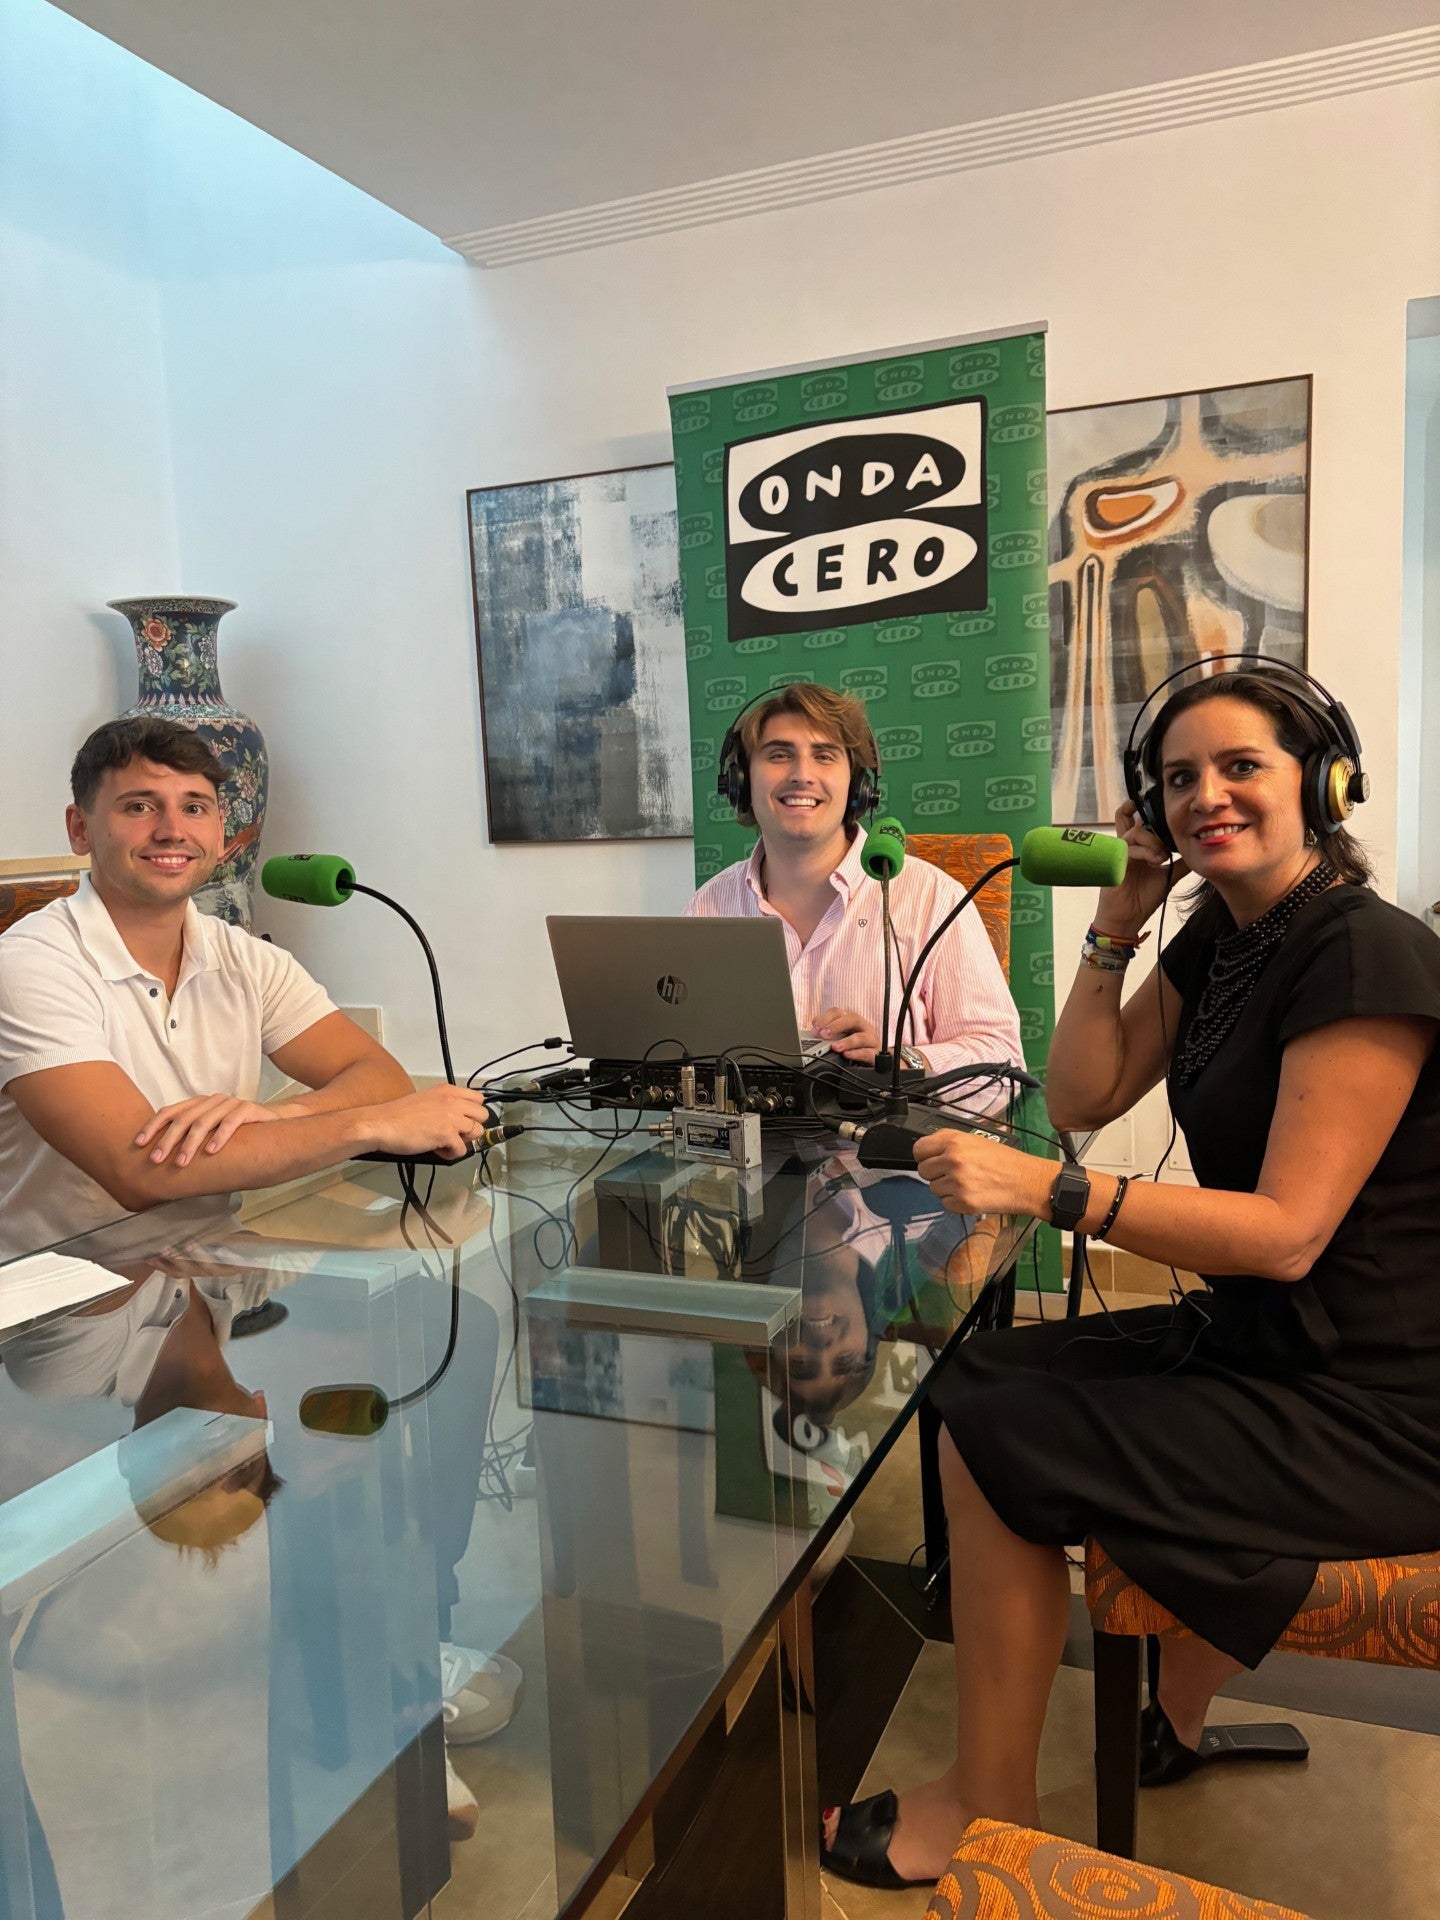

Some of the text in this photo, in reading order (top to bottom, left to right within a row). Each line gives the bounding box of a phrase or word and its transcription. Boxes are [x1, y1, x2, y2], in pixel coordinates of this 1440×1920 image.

[955, 356, 993, 370] ONDA
[957, 373, 994, 387] CERO
[995, 411, 1033, 424] ONDA
[998, 427, 1036, 440] CERO
[759, 453, 943, 515] ONDA
[996, 537, 1035, 549] ONDA
[998, 553, 1035, 566] CERO
[772, 536, 945, 597] CERO
[954, 621, 990, 633] CERO
[809, 633, 841, 644] CERO
[882, 628, 916, 640] CERO
[741, 639, 773, 650] CERO
[991, 660, 1030, 672] ONDA
[845, 673, 881, 684] ONDA
[917, 668, 954, 679] ONDA
[709, 682, 741, 693] ONDA
[994, 676, 1030, 688] CERO
[920, 682, 955, 695] CERO
[880, 732, 916, 743] ONDA
[953, 728, 989, 738] ONDA
[882, 747, 917, 759] CERO
[955, 742, 990, 754] CERO
[918, 787, 954, 798] ONDA
[991, 783, 1030, 793] ONDA
[920, 802, 955, 812] CERO
[993, 797, 1030, 808] CERO
